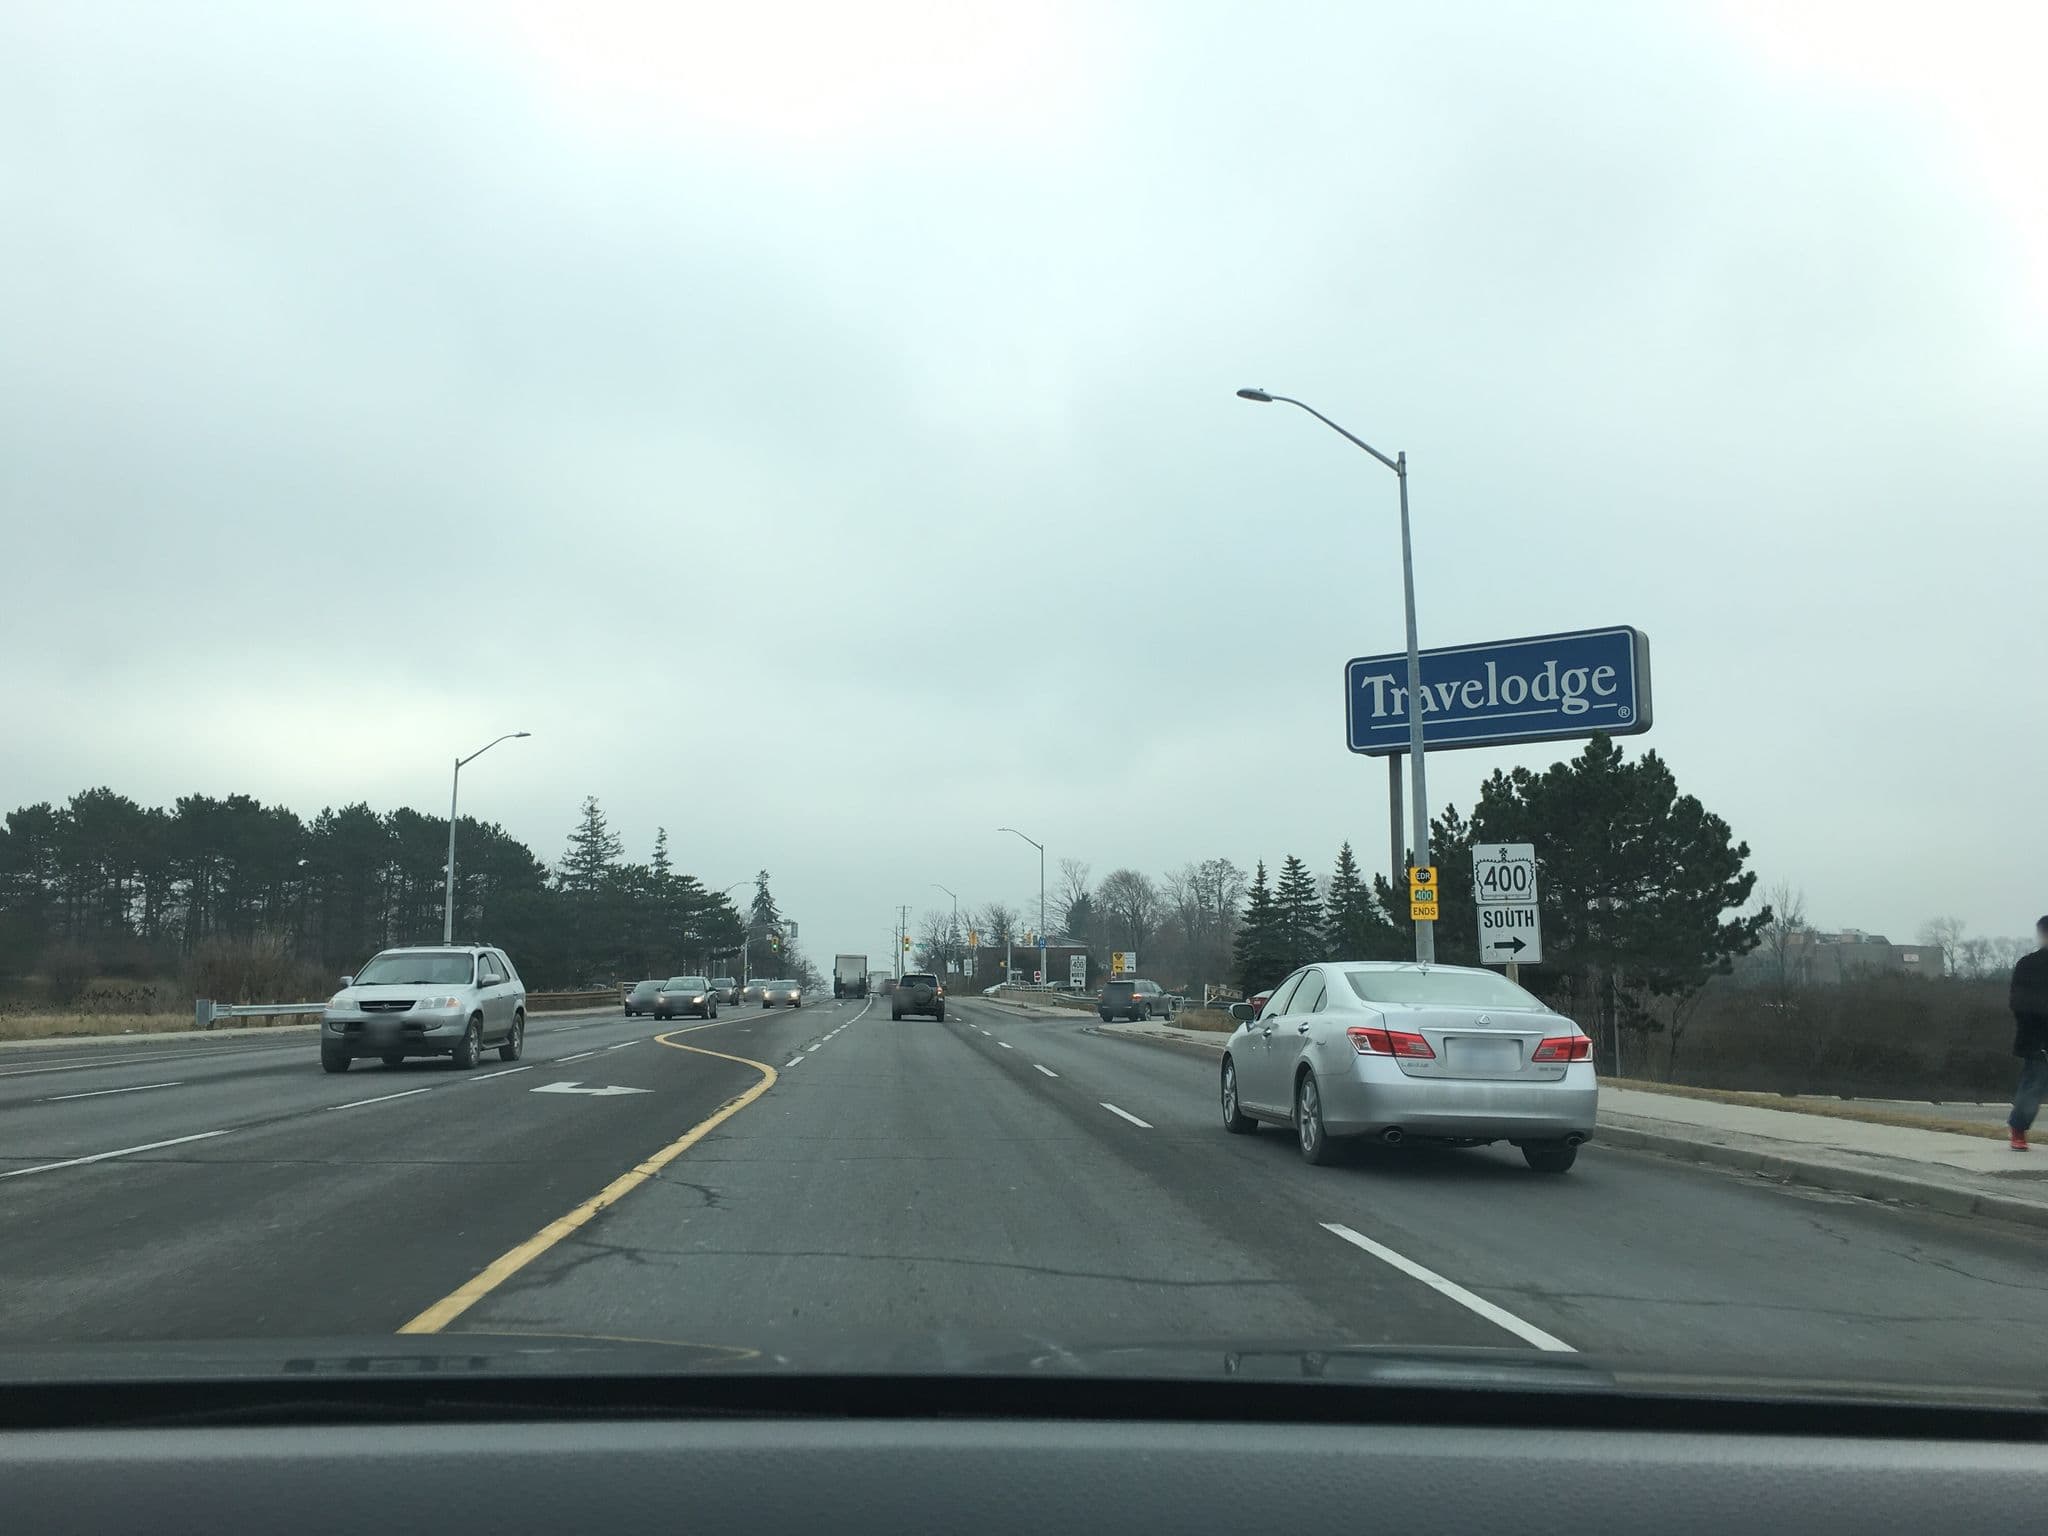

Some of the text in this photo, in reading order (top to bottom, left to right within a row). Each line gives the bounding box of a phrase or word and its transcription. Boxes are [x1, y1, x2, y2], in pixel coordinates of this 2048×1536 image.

[1361, 660, 1617, 716] Travelodge
[1416, 872, 1430, 880] EDR
[1484, 866, 1527, 891] 400
[1416, 891, 1432, 901] 400
[1413, 907, 1436, 915] ENDS
[1483, 910, 1534, 928] SOUTH
